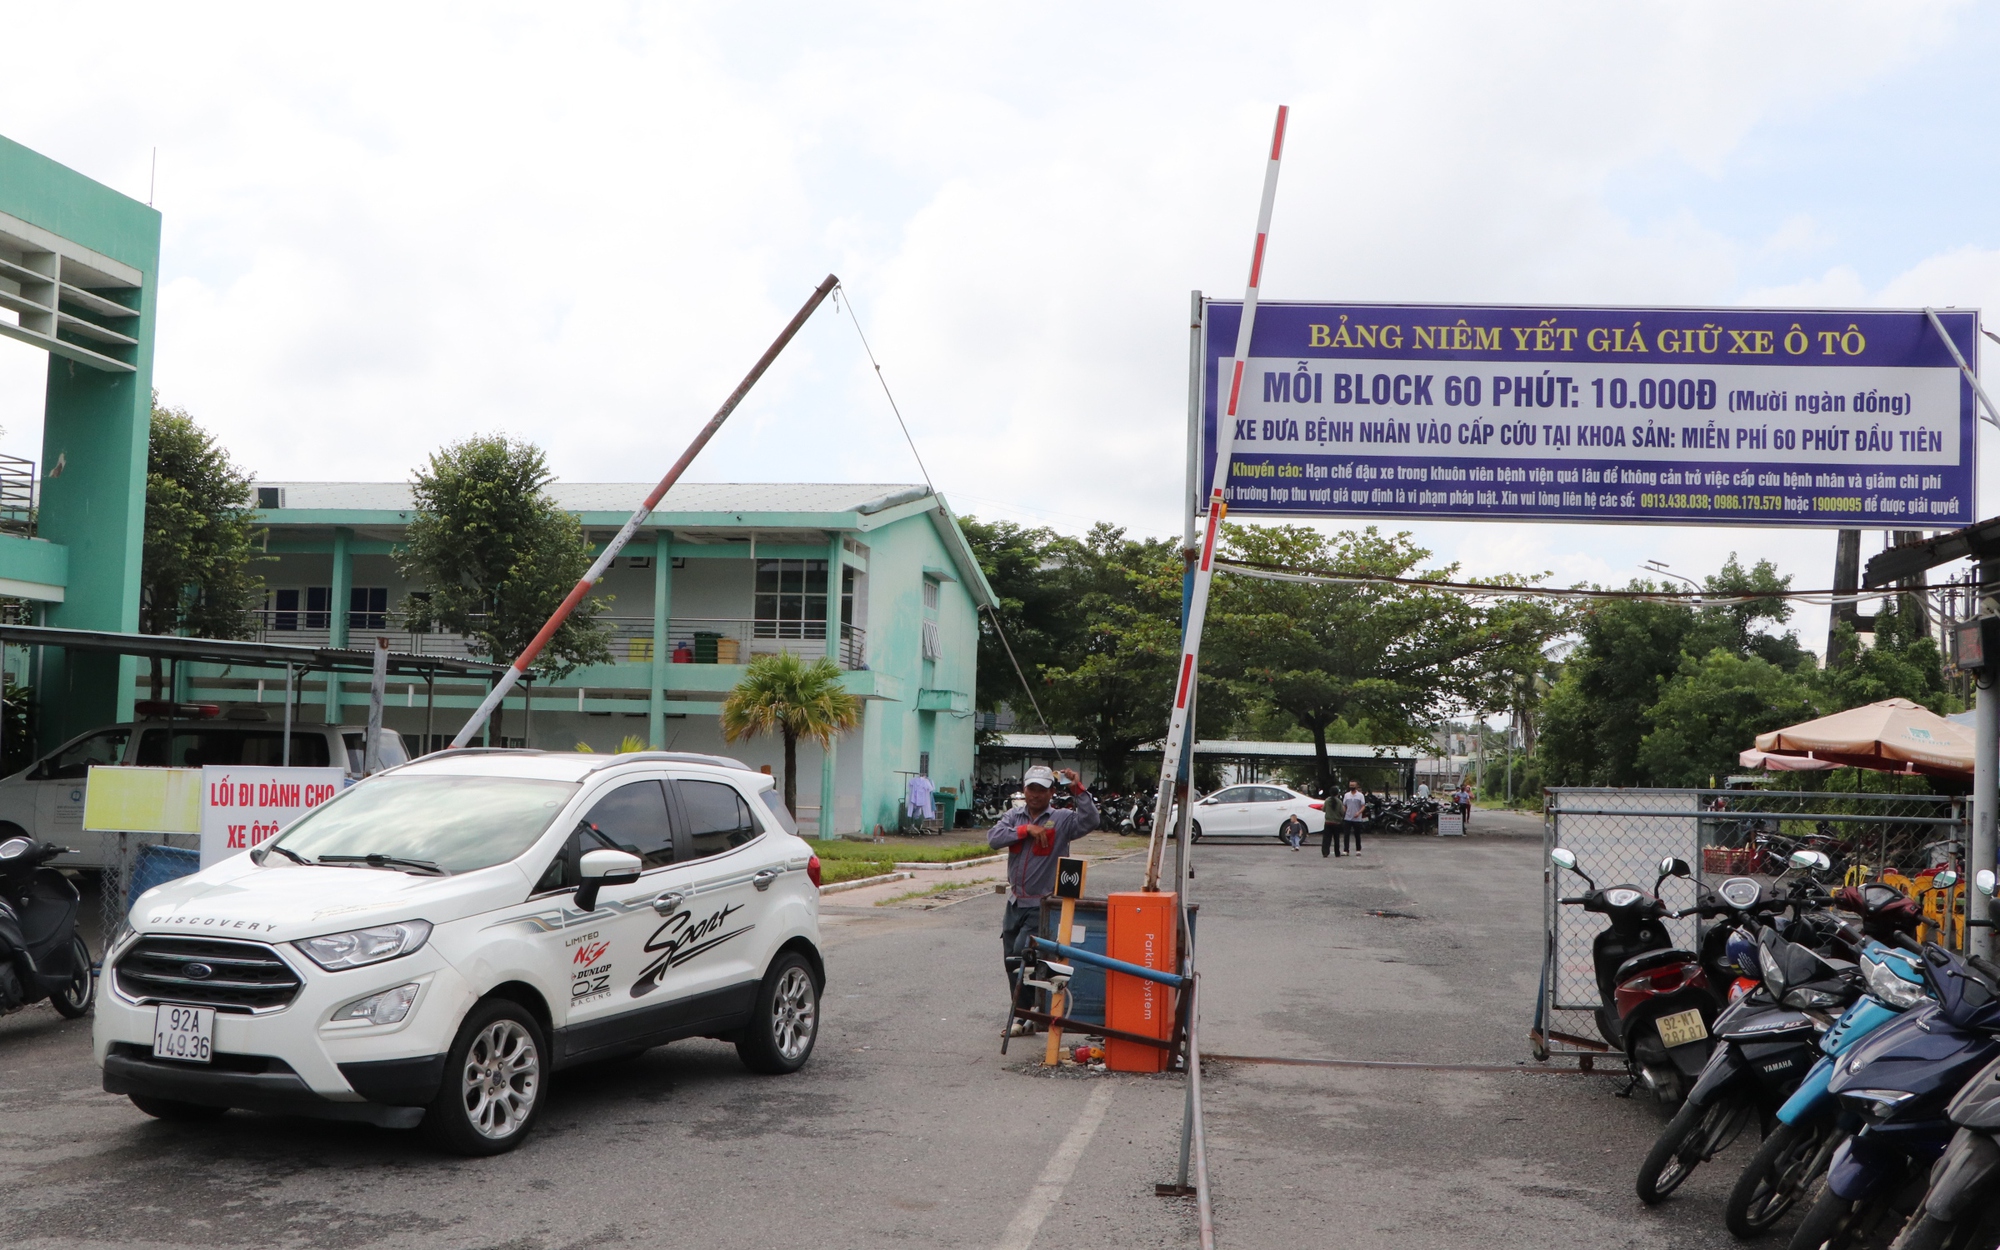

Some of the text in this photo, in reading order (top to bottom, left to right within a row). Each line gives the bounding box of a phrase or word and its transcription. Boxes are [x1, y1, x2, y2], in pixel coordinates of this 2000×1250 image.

[1308, 315, 1866, 356] BẢNG NIÊM YẾT GIÁ GIỮ XE Ô TÔ
[1263, 360, 1912, 416] MỖI BLOCK 60 PHÚT: 10.000Đ (Mười ngàn đồng)
[1234, 416, 1942, 452] XE ĐƯA BỆNH NHÂN VÀO CẤP CỨU TẠI KHOA SẢN: MIỄN PHÍ 60 PHÚT ĐẦU TIÊN
[1232, 460, 1942, 491] Khuyến cáo: Hạn chế đậu xe trong khuôn viên bệnh viện quá lâu để không cản trở việc cấp cứu bệnh nhân và giảm chi phí
[1236, 485, 1268, 503] trường
[1270, 486, 1289, 504] hợp
[1291, 486, 1307, 501] thu
[1309, 487, 1331, 505] vượt
[1332, 487, 1349, 504] giá
[1351, 490, 1369, 504] quy
[1371, 488, 1393, 506] định
[1395, 487, 1405, 504] là
[1407, 489, 1417, 504] vi
[1419, 489, 1447, 507] phạm
[1449, 489, 1474, 507] pháp
[1477, 490, 1499, 508] luật.
[1501, 490, 1518, 506] Xin
[1520, 491, 1536, 506] vui
[1538, 490, 1560, 508] lòng
[1562, 491, 1582, 507] liên
[1584, 491, 1597, 510] hệ
[1599, 492, 1618, 508] các
[1620, 490, 1636, 508] số:
[1640, 492, 1712, 511] 0913.438.038;
[1713, 494, 1782, 511] 0986.179.579
[1784, 495, 1809, 514] hoặc
[1812, 496, 1862, 512] 19009095
[1864, 494, 1878, 513] để
[1880, 497, 1905, 516] được
[1908, 496, 1928, 515] giải
[1930, 496, 1959, 516] quyết
[210, 774, 335, 808] LỐI ĐI DÀNH CHO
[226, 824, 247, 849] XE
[150, 916, 277, 933] DISCOVERY
[565, 930, 599, 947] LIMITED
[635, 903, 747, 985] Sport
[576, 963, 612, 980] DUNLOP
[1142, 933, 1155, 1020] Parkin System
[570, 991, 612, 1008] RACING
[170, 1008, 200, 1033] 92A
[1663, 1012, 1695, 1031] 92-N1
[1738, 1021, 1786, 1033] JUPITER
[157, 1031, 210, 1060] 149.36
[1762, 1059, 1794, 1073] YAMAHA
